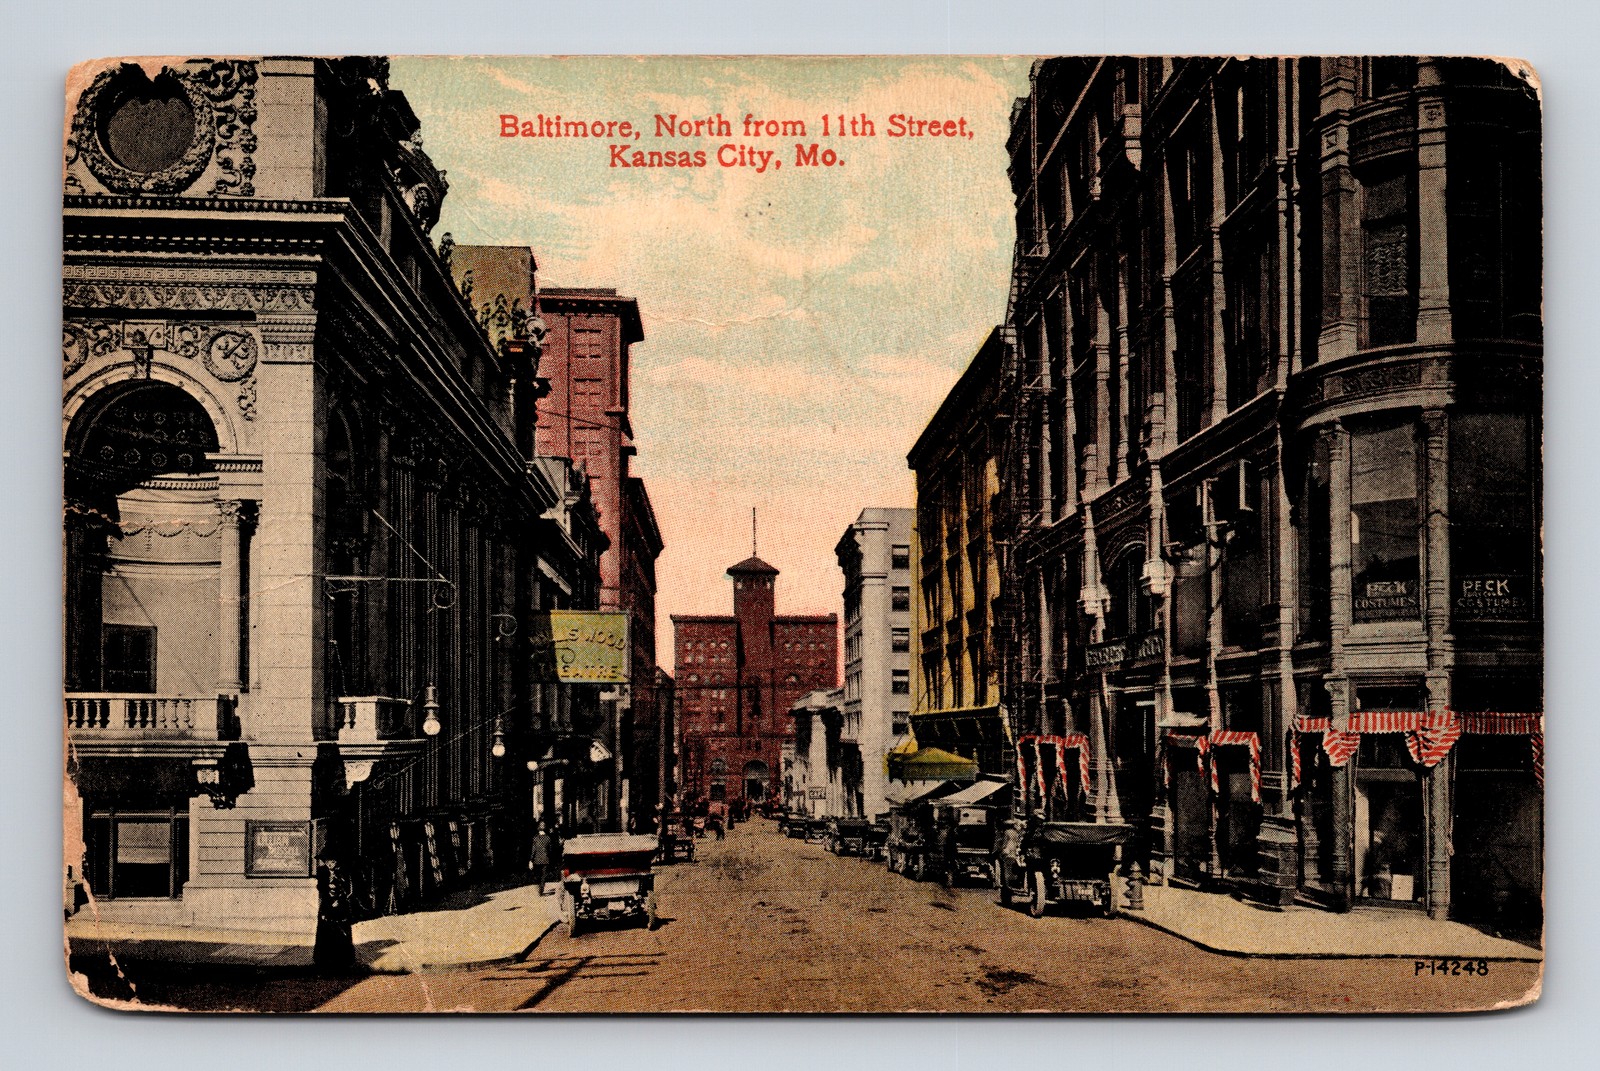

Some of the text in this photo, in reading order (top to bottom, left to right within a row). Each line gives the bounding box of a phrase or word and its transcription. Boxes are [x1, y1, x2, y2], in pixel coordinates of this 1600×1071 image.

[1367, 580, 1407, 597] PECK
[1463, 578, 1511, 597] PECK
[1354, 596, 1417, 609] COSTUMES
